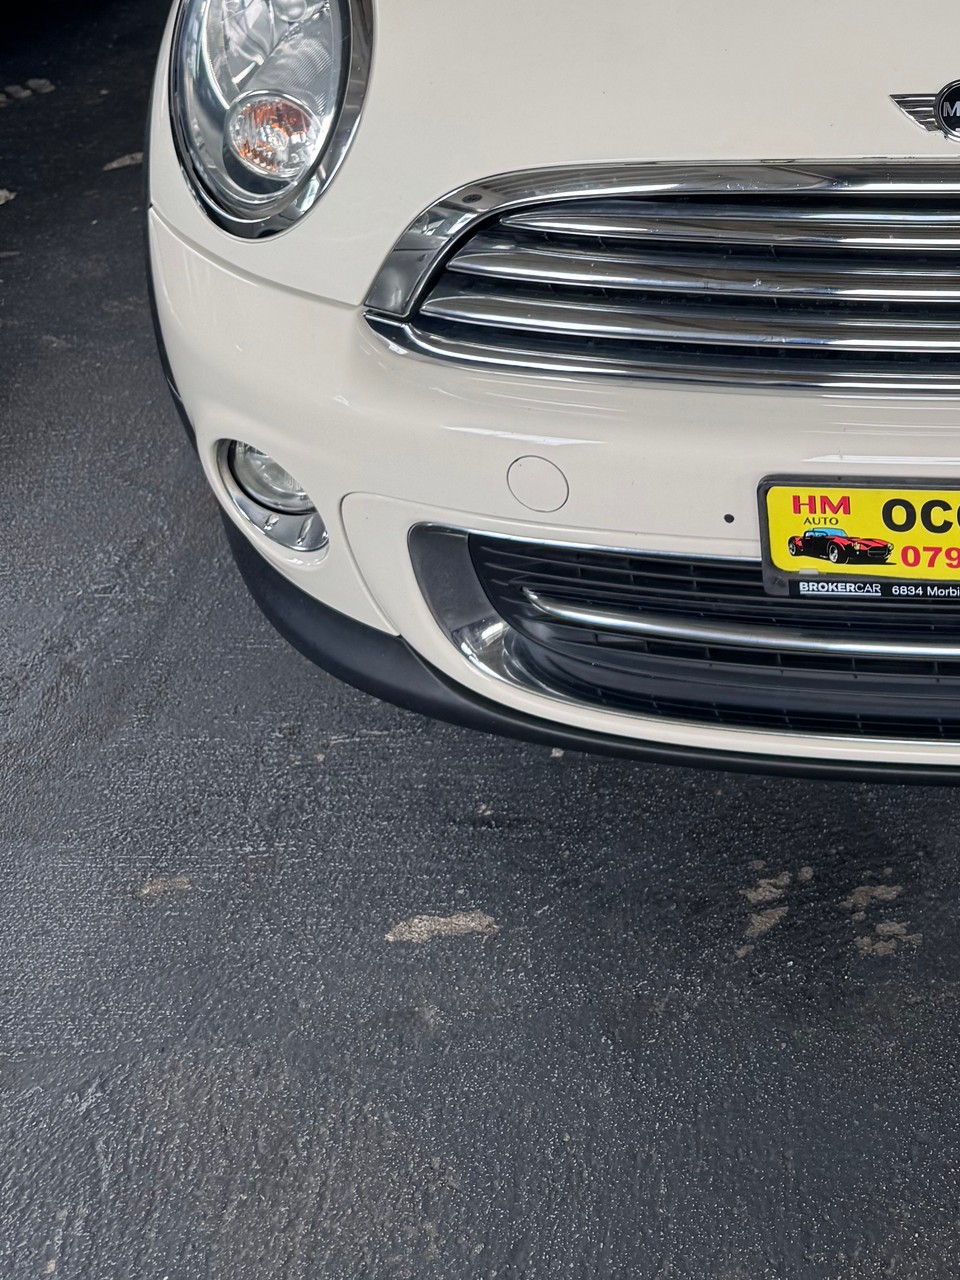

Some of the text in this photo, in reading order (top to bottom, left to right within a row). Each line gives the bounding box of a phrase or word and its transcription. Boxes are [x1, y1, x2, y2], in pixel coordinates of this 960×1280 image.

[792, 495, 850, 515] HM
[803, 516, 839, 526] AUTO
[800, 582, 881, 594] BROKERCAR
[892, 585, 923, 596] 6834
